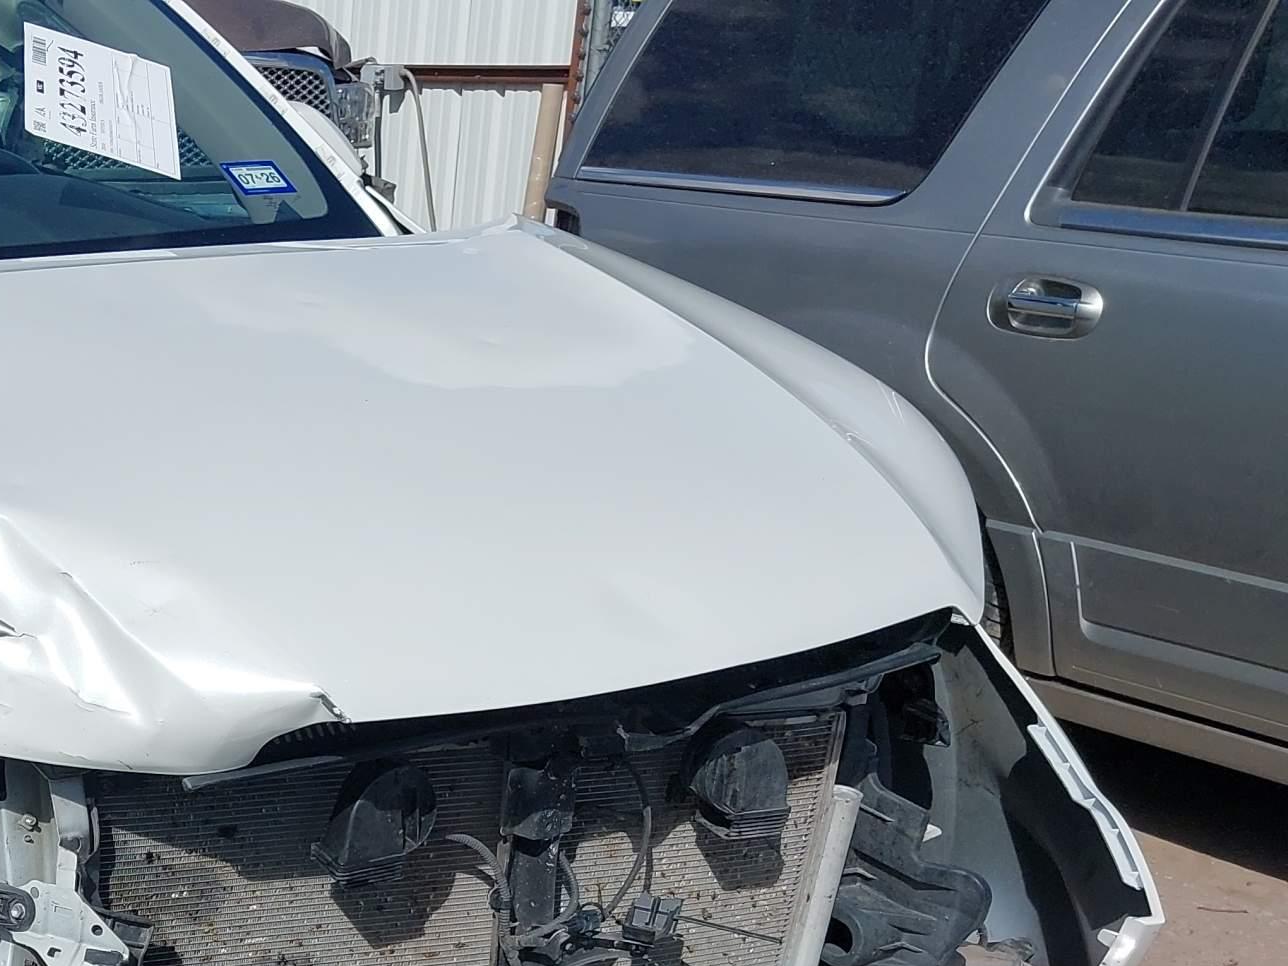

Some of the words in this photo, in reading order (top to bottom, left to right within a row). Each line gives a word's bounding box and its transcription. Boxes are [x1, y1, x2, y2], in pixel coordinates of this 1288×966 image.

[57, 46, 88, 136] 43273594
[238, 173, 256, 185] 07
[261, 172, 281, 184] 26
